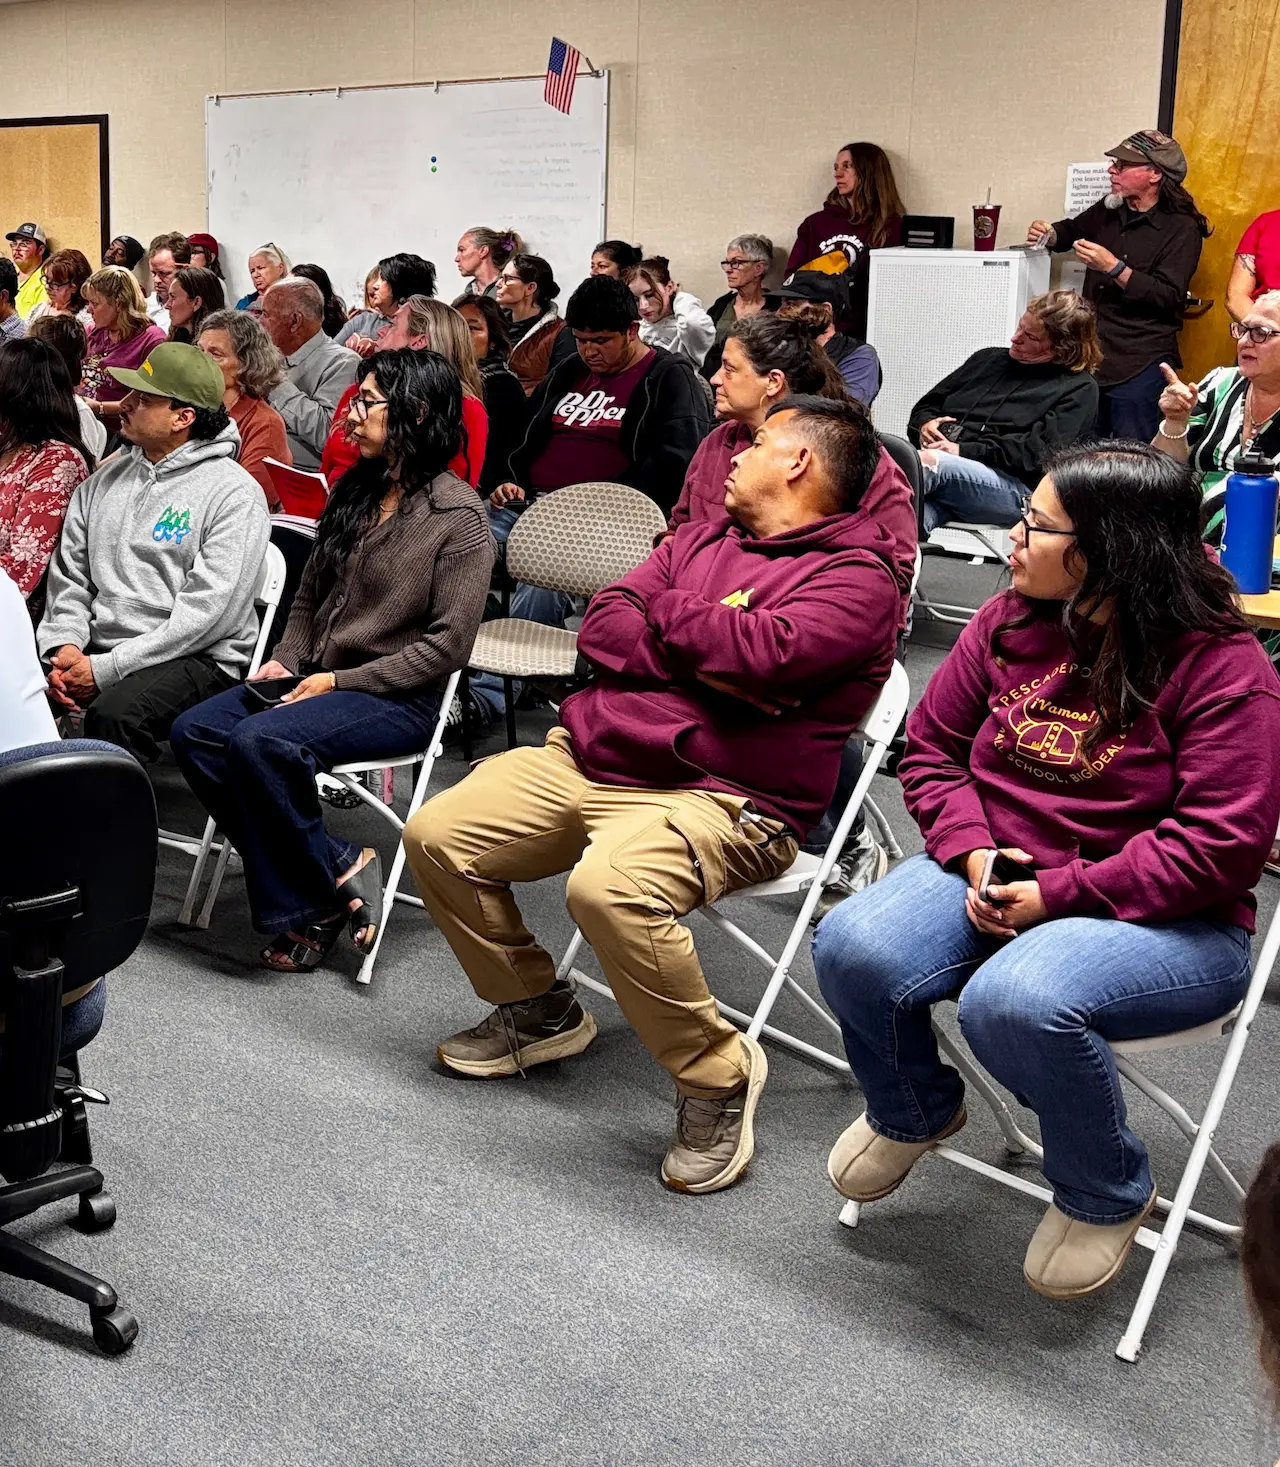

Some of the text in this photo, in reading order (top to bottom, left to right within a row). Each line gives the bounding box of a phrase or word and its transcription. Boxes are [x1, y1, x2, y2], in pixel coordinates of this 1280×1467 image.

[579, 390, 616, 410] Dr
[1069, 768, 1093, 783] BIG
[1091, 744, 1125, 771] DEAL
